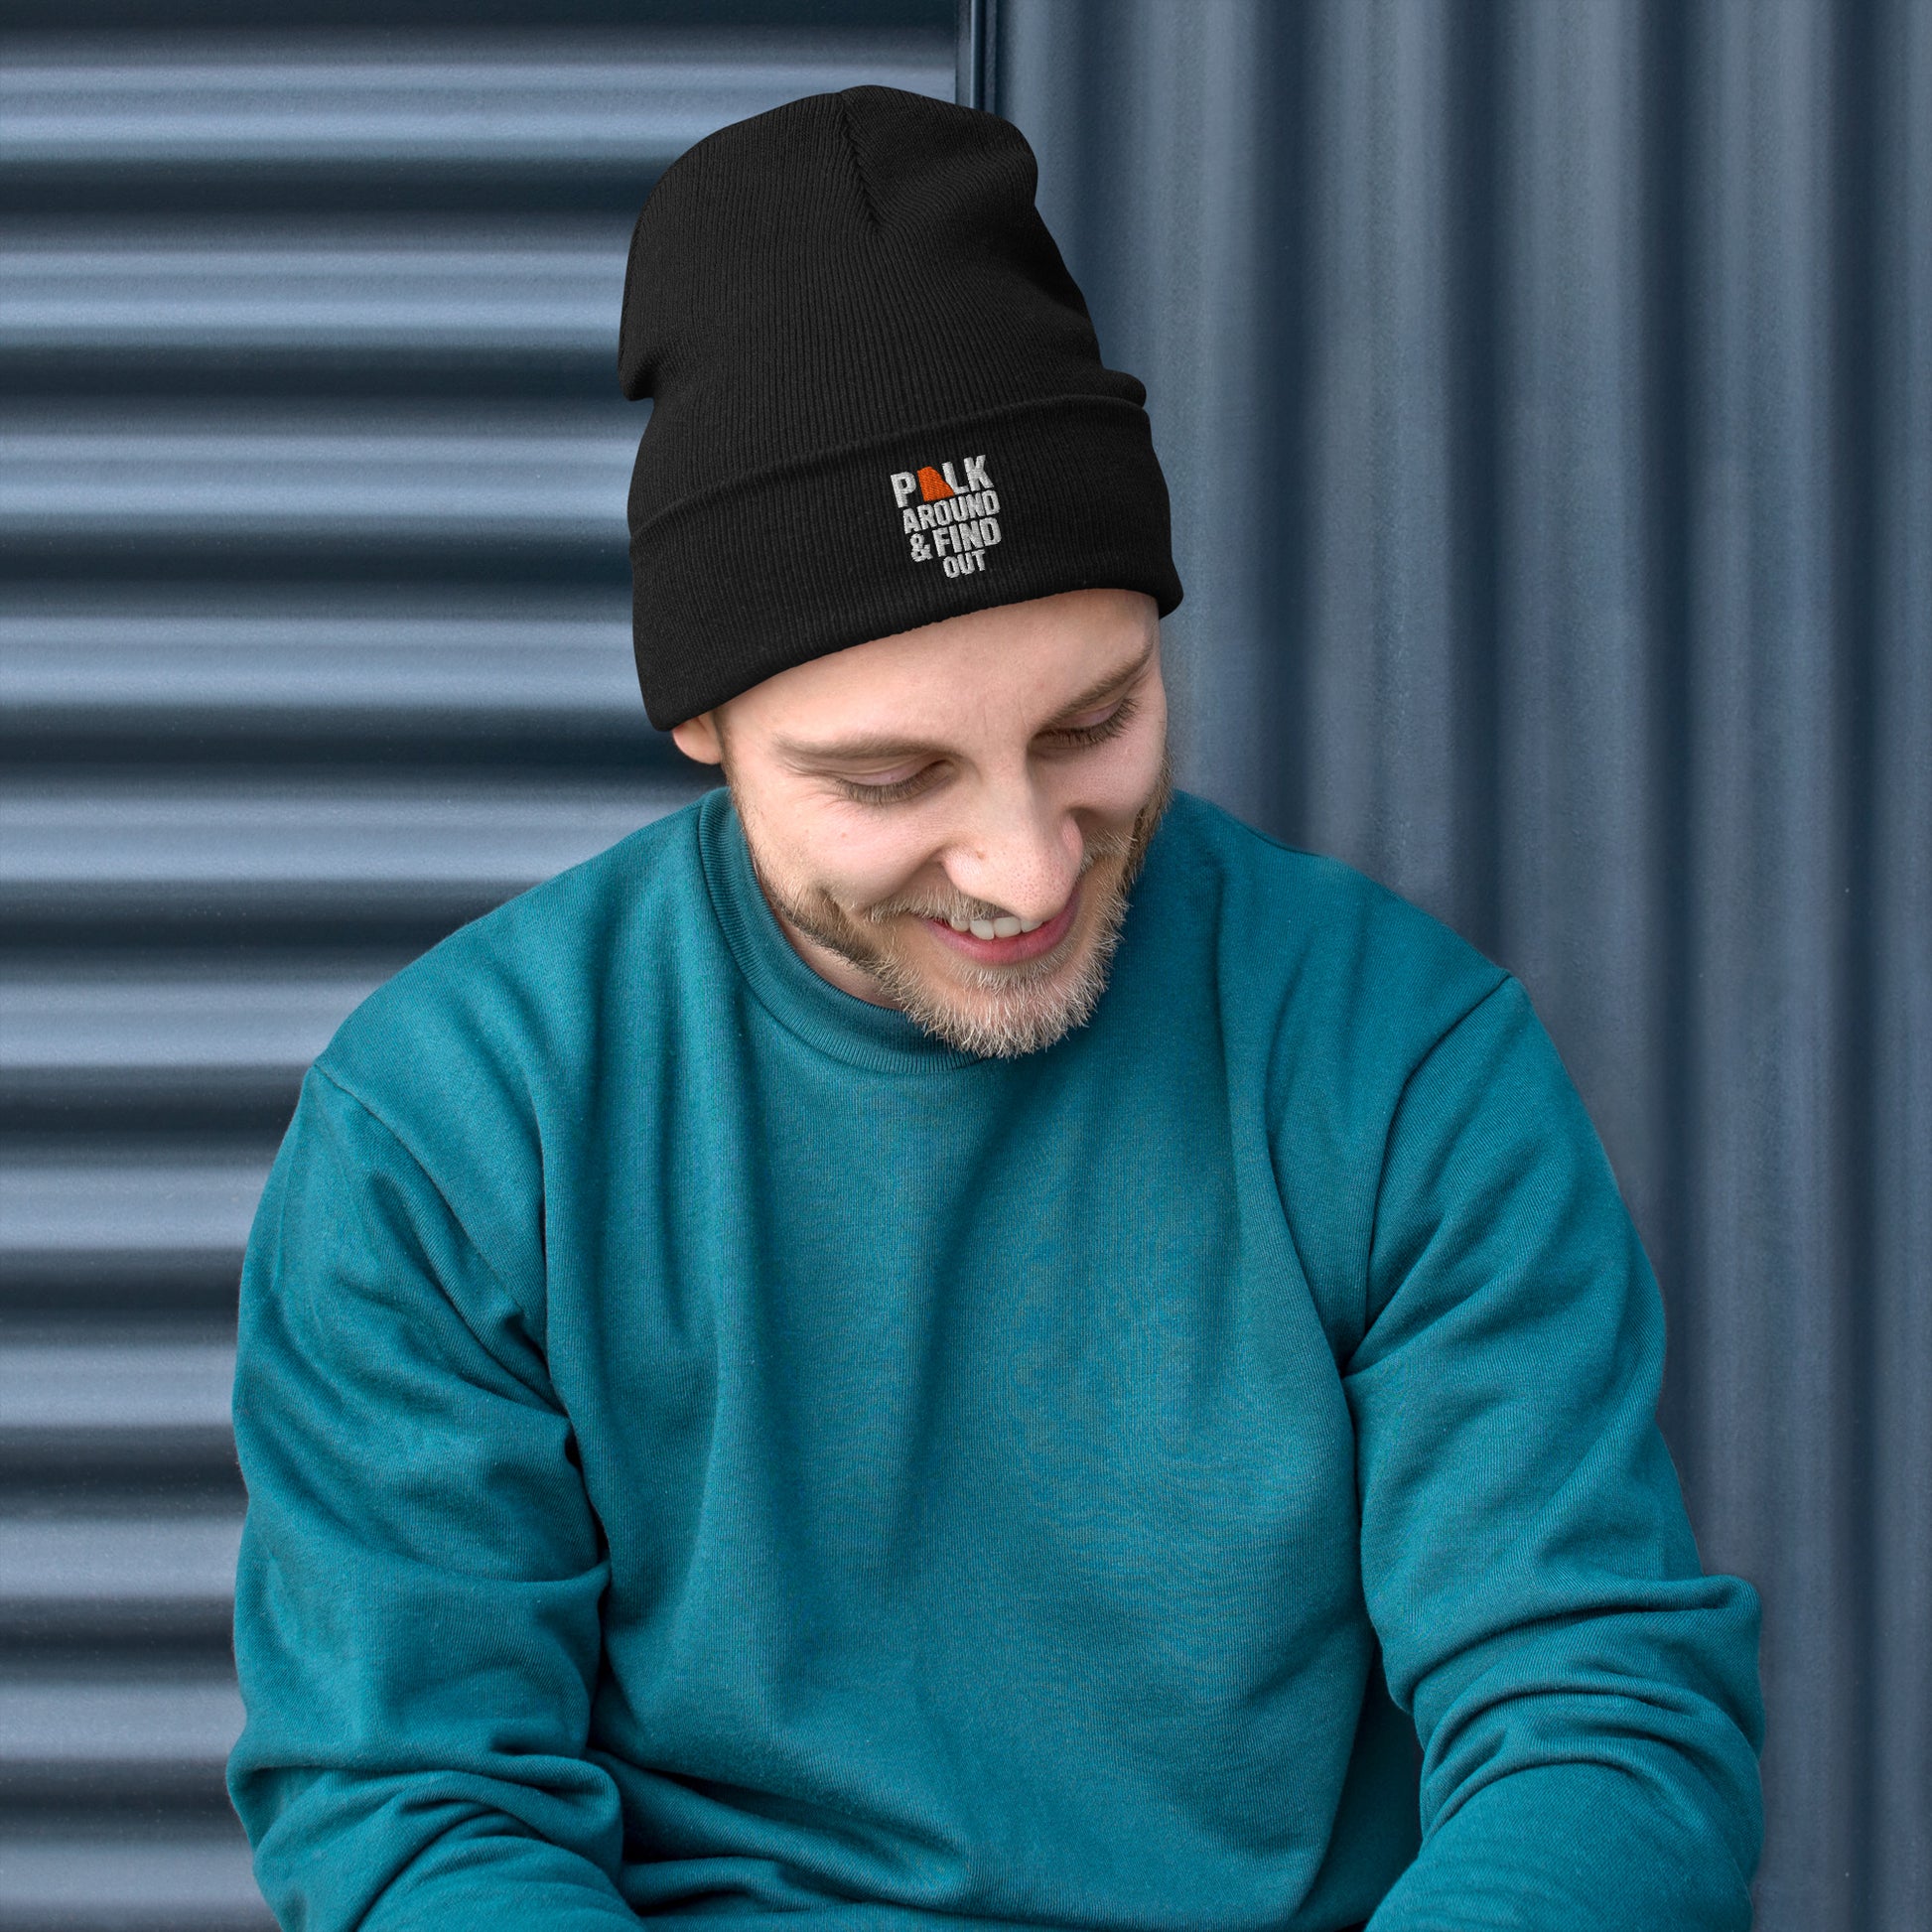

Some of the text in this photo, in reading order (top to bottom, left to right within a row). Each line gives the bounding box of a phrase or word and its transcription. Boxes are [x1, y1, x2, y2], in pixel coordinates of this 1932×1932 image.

[902, 489, 1001, 534] AROUND
[909, 516, 1002, 562] & FIND
[942, 549, 986, 578] OUT
